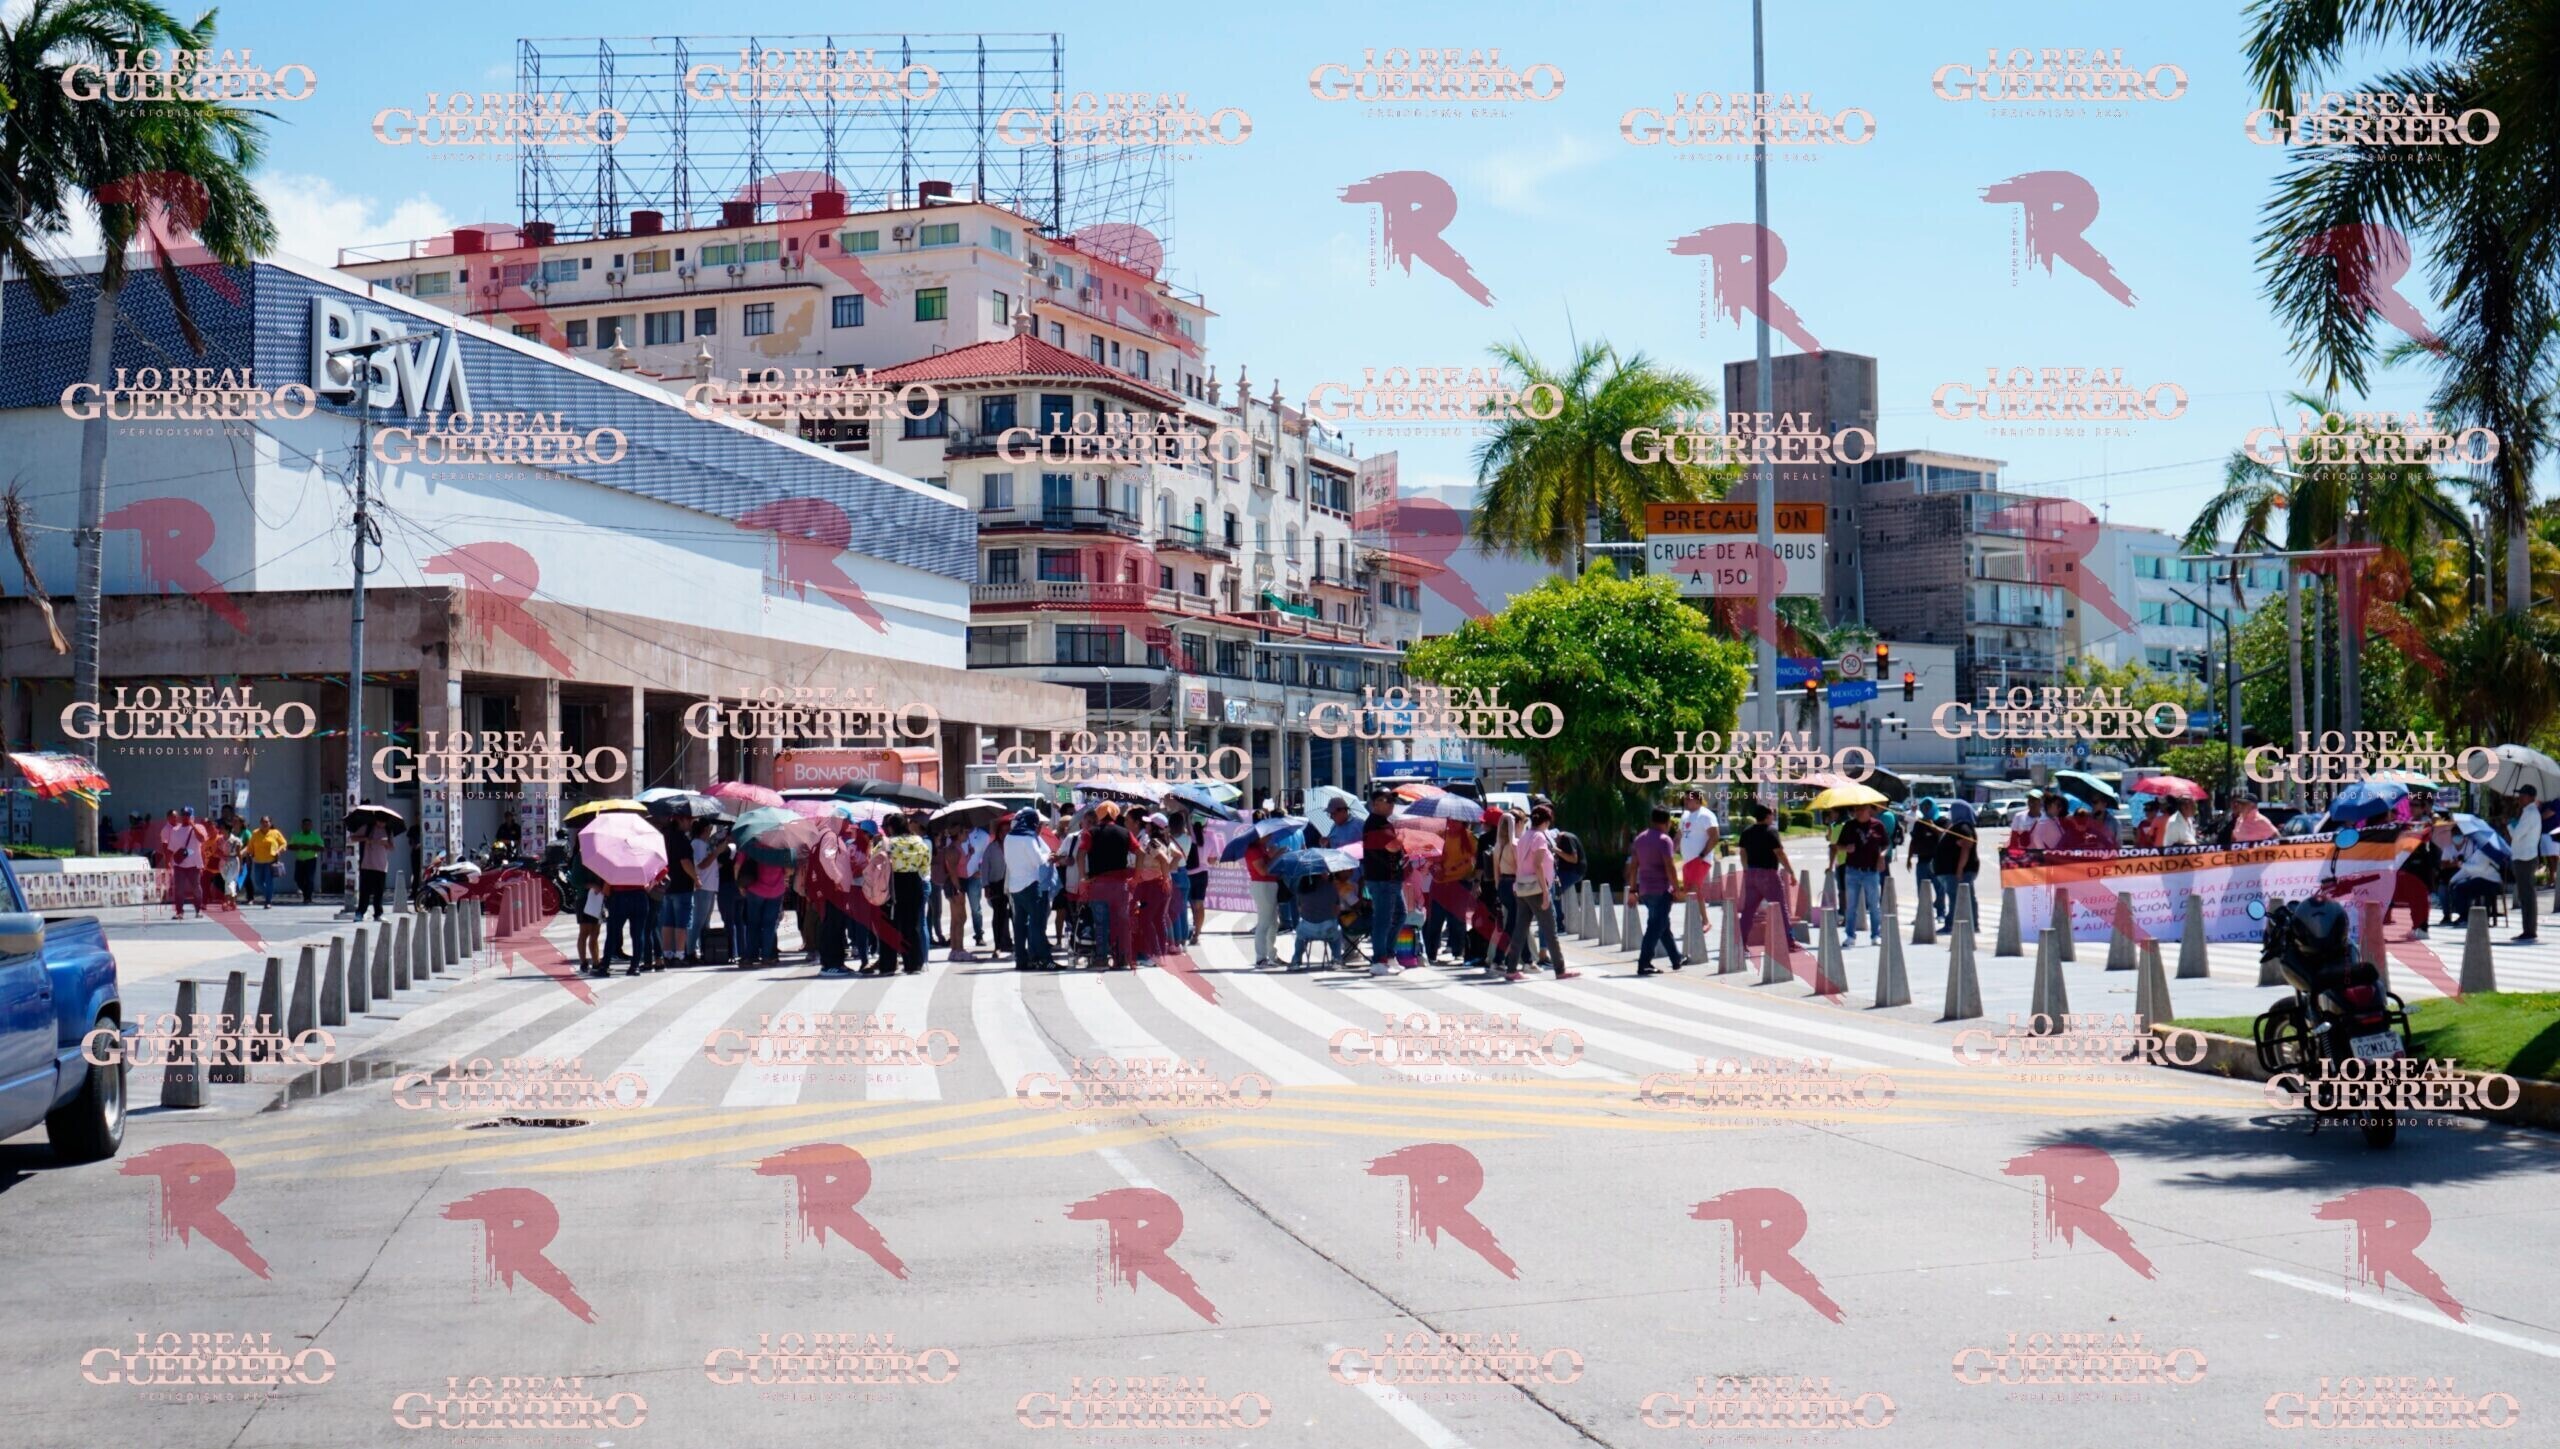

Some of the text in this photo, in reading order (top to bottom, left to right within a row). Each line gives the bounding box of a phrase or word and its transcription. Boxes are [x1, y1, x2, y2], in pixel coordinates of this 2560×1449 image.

[311, 296, 473, 418] BBVA
[1663, 510, 1807, 529] PRECAUON
[1654, 543, 1816, 560] CRUCE DE AOBUS
[1690, 569, 1748, 585] A 150
[1846, 659, 1857, 669] 50
[794, 763, 880, 781] BONAFONT
[2163, 844, 2223, 856] ESTATAL
[2230, 841, 2246, 851] DE
[2253, 838, 2280, 848] LOS
[2087, 847, 2327, 878] DEMANDAS CENTRALES
[2081, 889, 2172, 905] ABROACIÓN
[2201, 885, 2216, 895] LA
[2220, 881, 2243, 892] LEY
[2246, 878, 2269, 889] DEL
[2221, 888, 2286, 904] REFORMA
